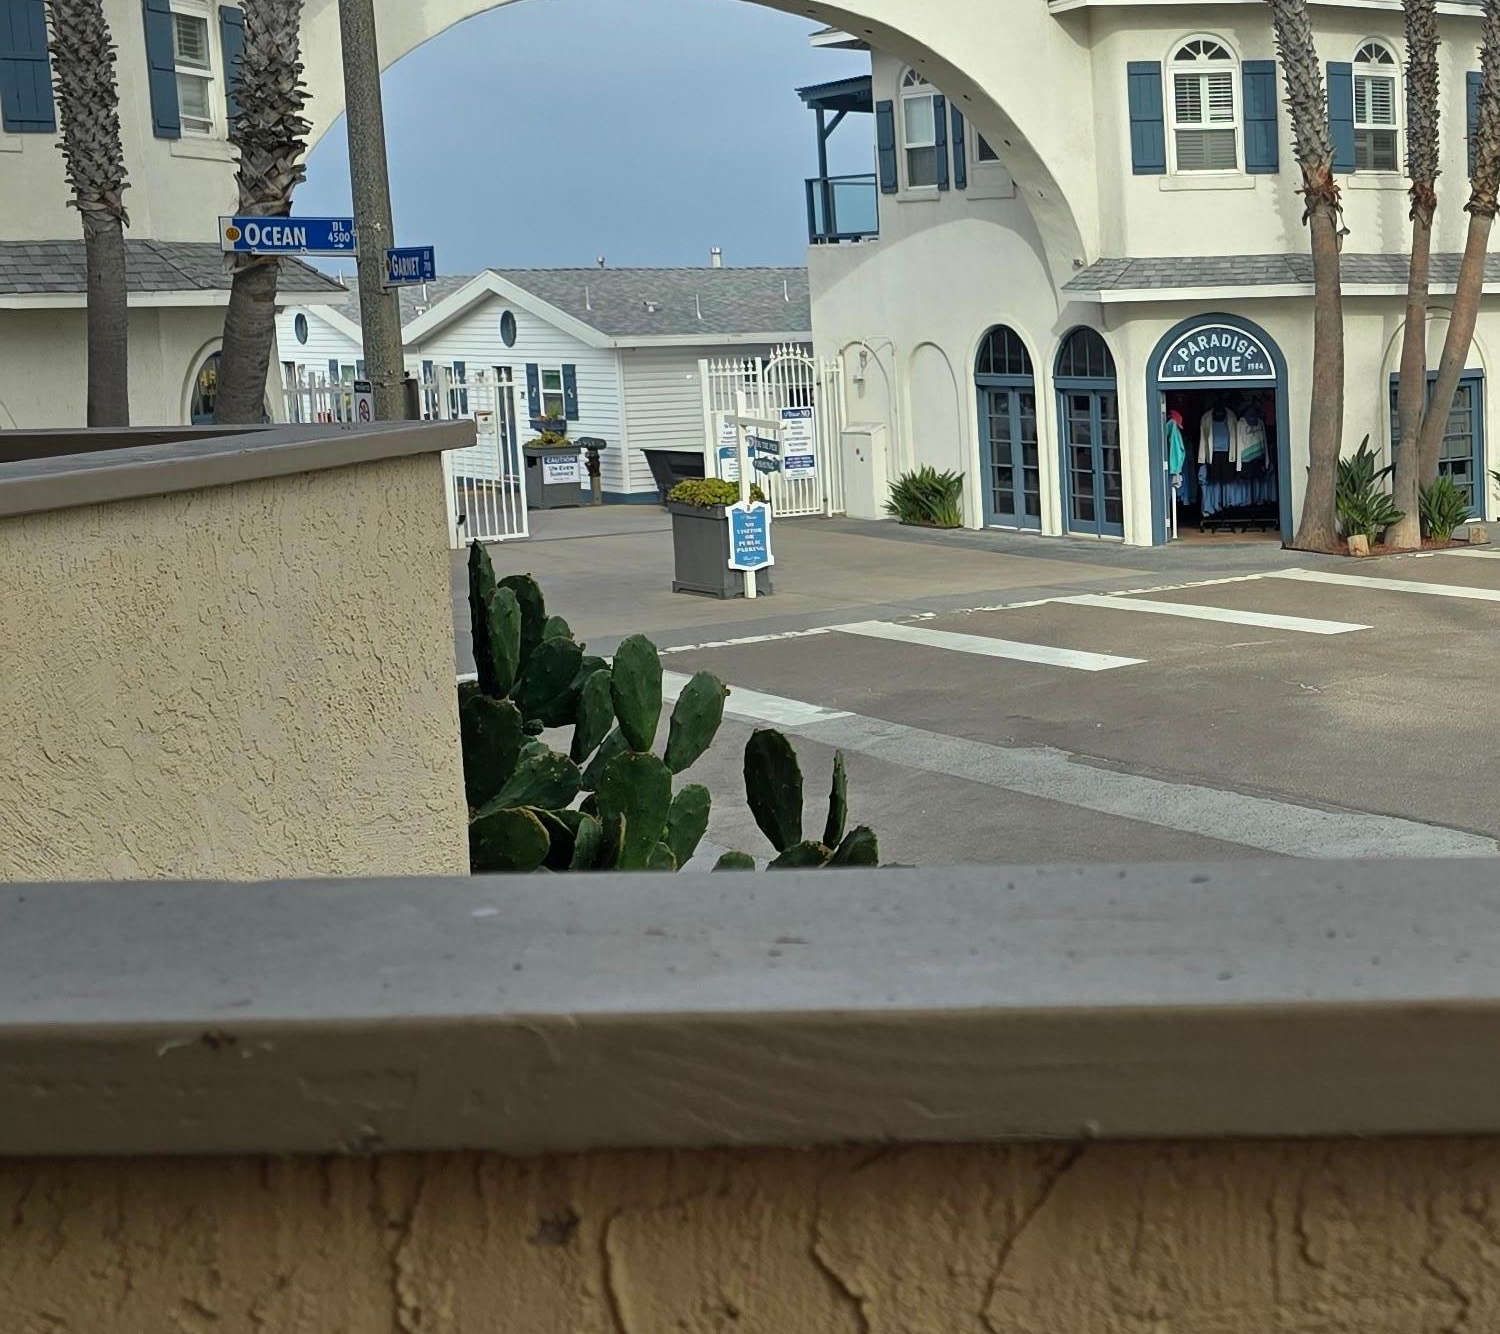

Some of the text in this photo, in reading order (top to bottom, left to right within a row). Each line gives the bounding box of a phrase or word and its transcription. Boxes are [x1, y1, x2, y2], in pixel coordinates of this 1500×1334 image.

[244, 222, 307, 247] OCEAN
[327, 231, 351, 243] 4500
[1178, 333, 1258, 362] PARADISE
[1173, 364, 1185, 372] EST
[1194, 356, 1242, 373] COVE
[736, 546, 765, 554] PARKING
